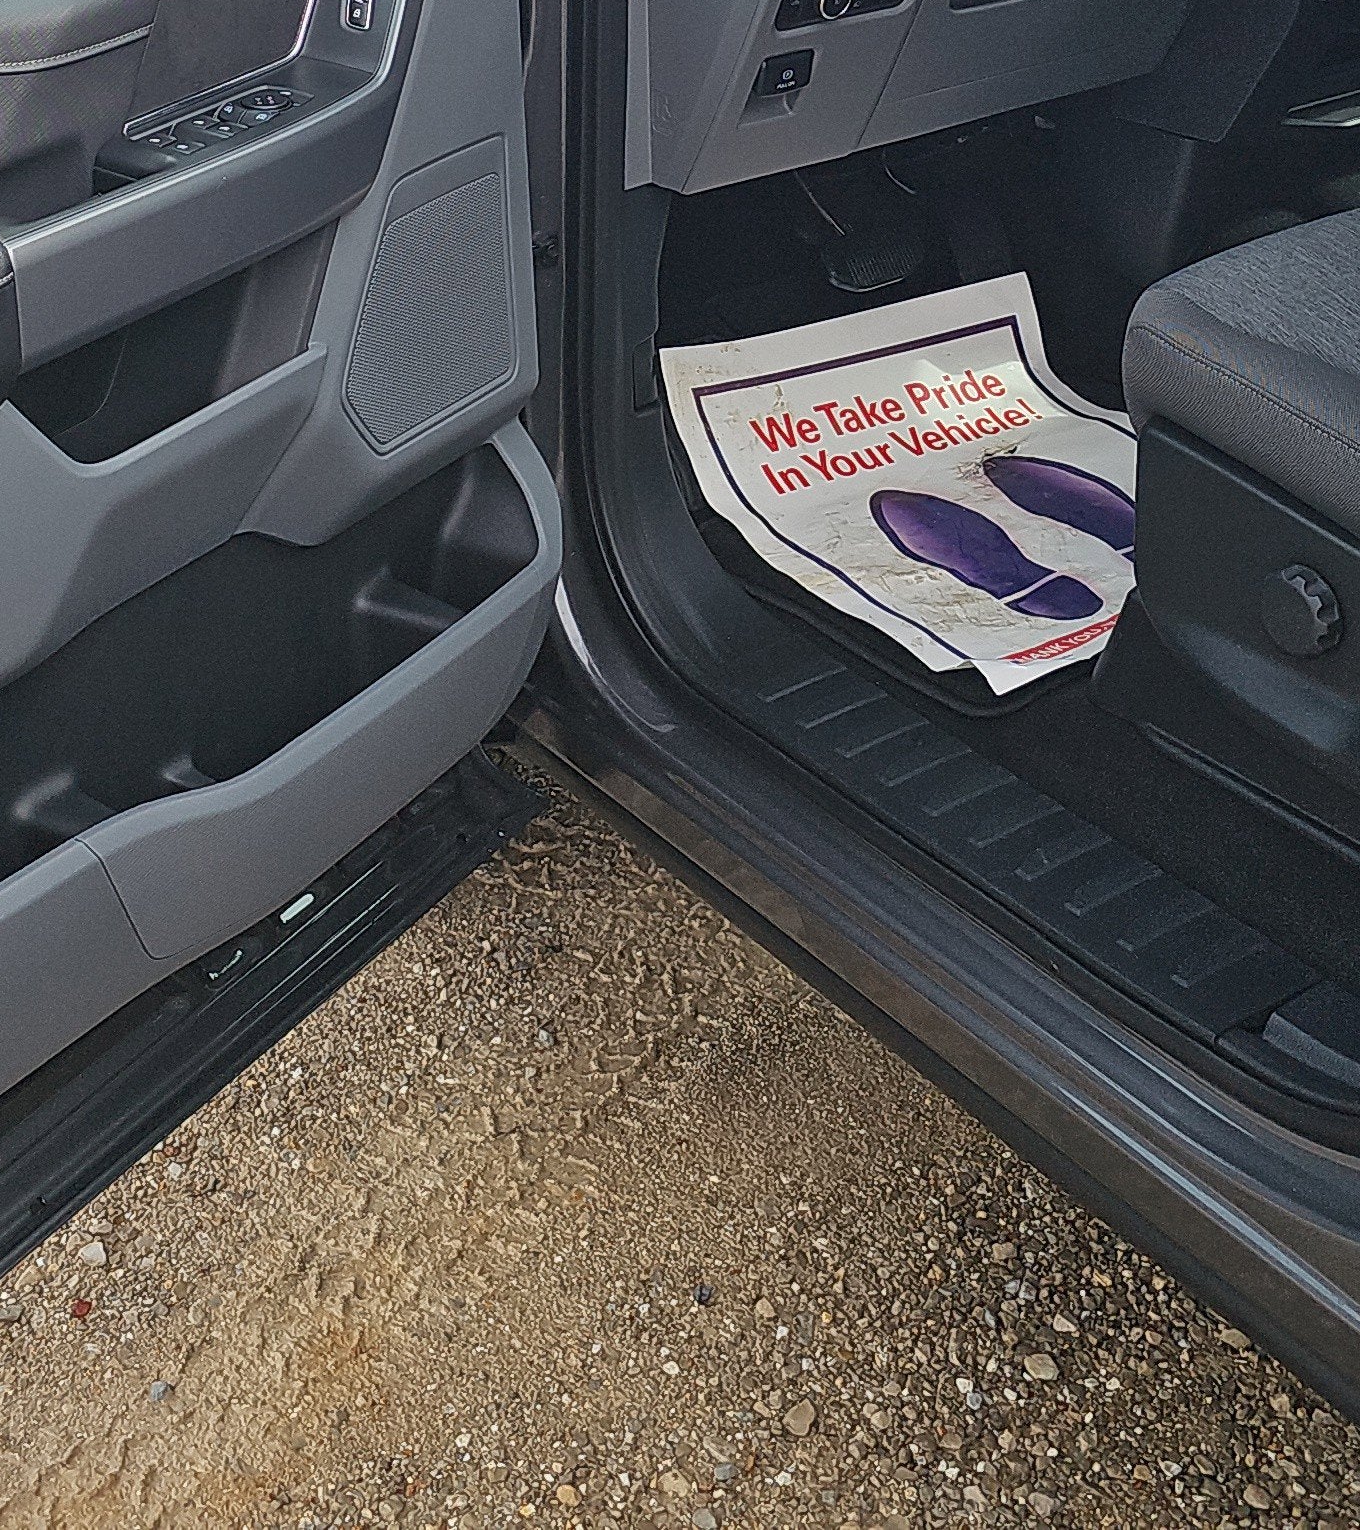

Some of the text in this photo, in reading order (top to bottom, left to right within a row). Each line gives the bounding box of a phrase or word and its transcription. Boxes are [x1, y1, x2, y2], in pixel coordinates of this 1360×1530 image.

[749, 370, 1007, 453] We Take Pride
[761, 398, 1044, 495] In Your Vehicle!
